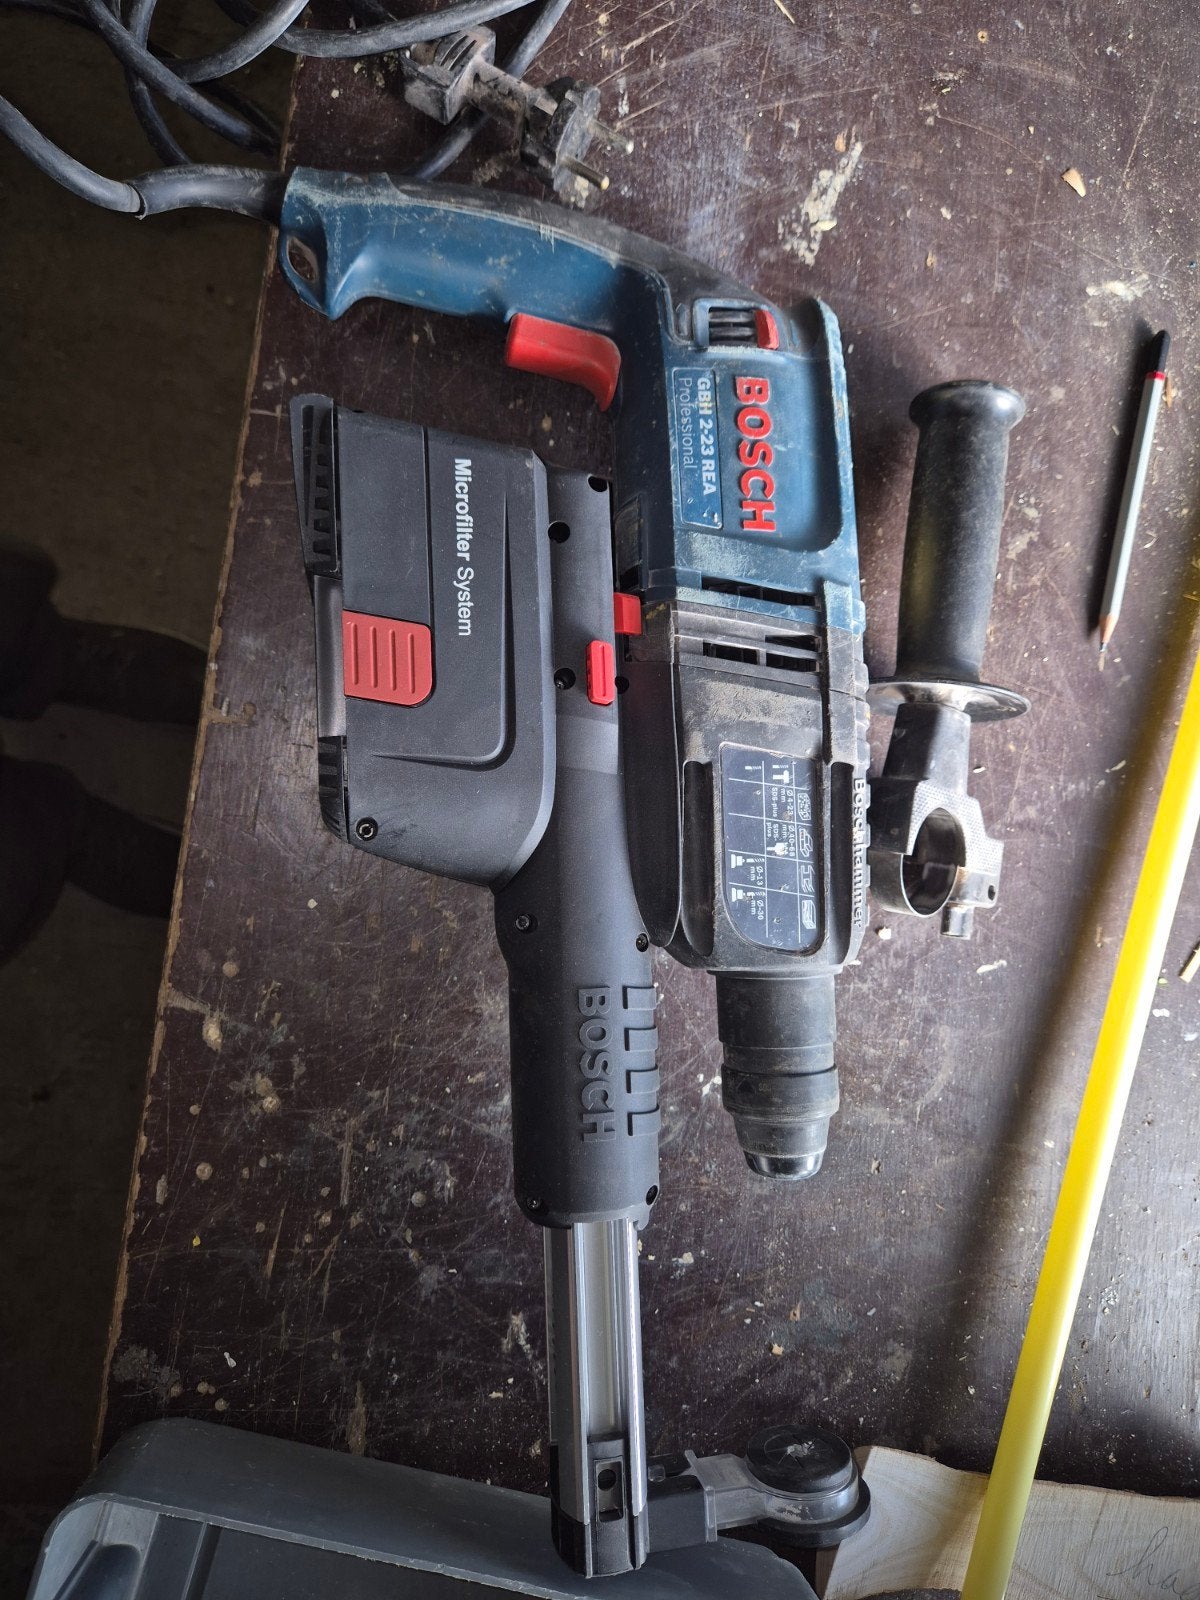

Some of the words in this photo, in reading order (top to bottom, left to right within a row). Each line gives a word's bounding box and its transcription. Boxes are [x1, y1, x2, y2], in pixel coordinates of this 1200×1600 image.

[678, 377, 697, 469] Professional
[697, 377, 713, 414] GBH
[699, 418, 715, 456] 2-23
[701, 459, 716, 495] REA
[734, 376, 777, 533] BOSCH
[454, 458, 474, 562] Microfilter
[453, 566, 475, 636] System
[577, 986, 617, 1143] BOSCH
